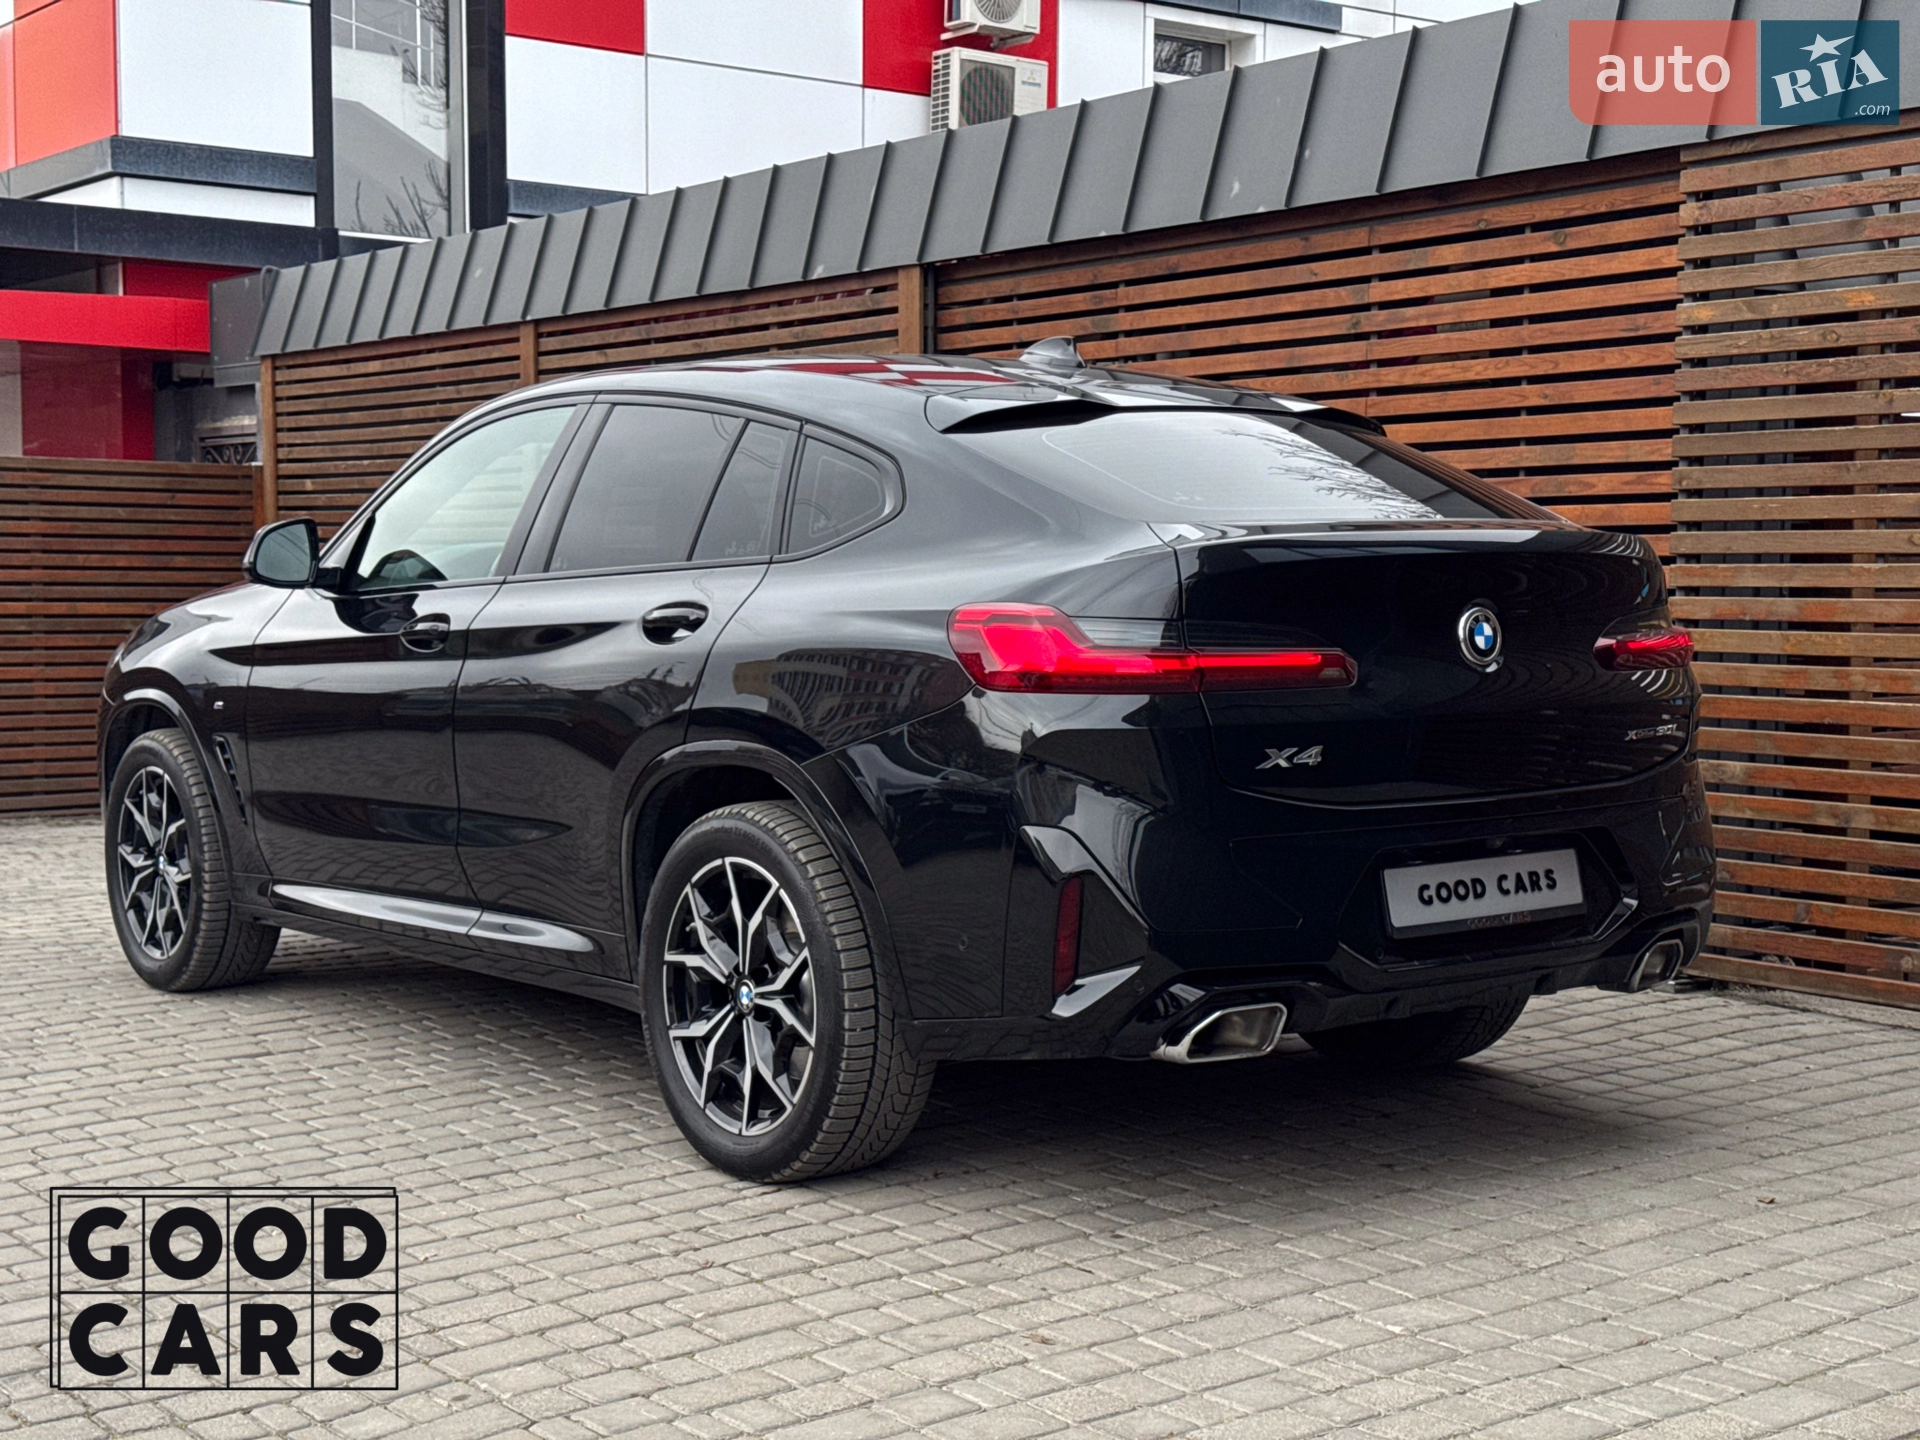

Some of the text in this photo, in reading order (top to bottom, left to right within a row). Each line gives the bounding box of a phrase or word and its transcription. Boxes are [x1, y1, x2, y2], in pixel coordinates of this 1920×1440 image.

[1255, 745, 1324, 769] X4
[1417, 868, 1557, 906] GOOD CARS
